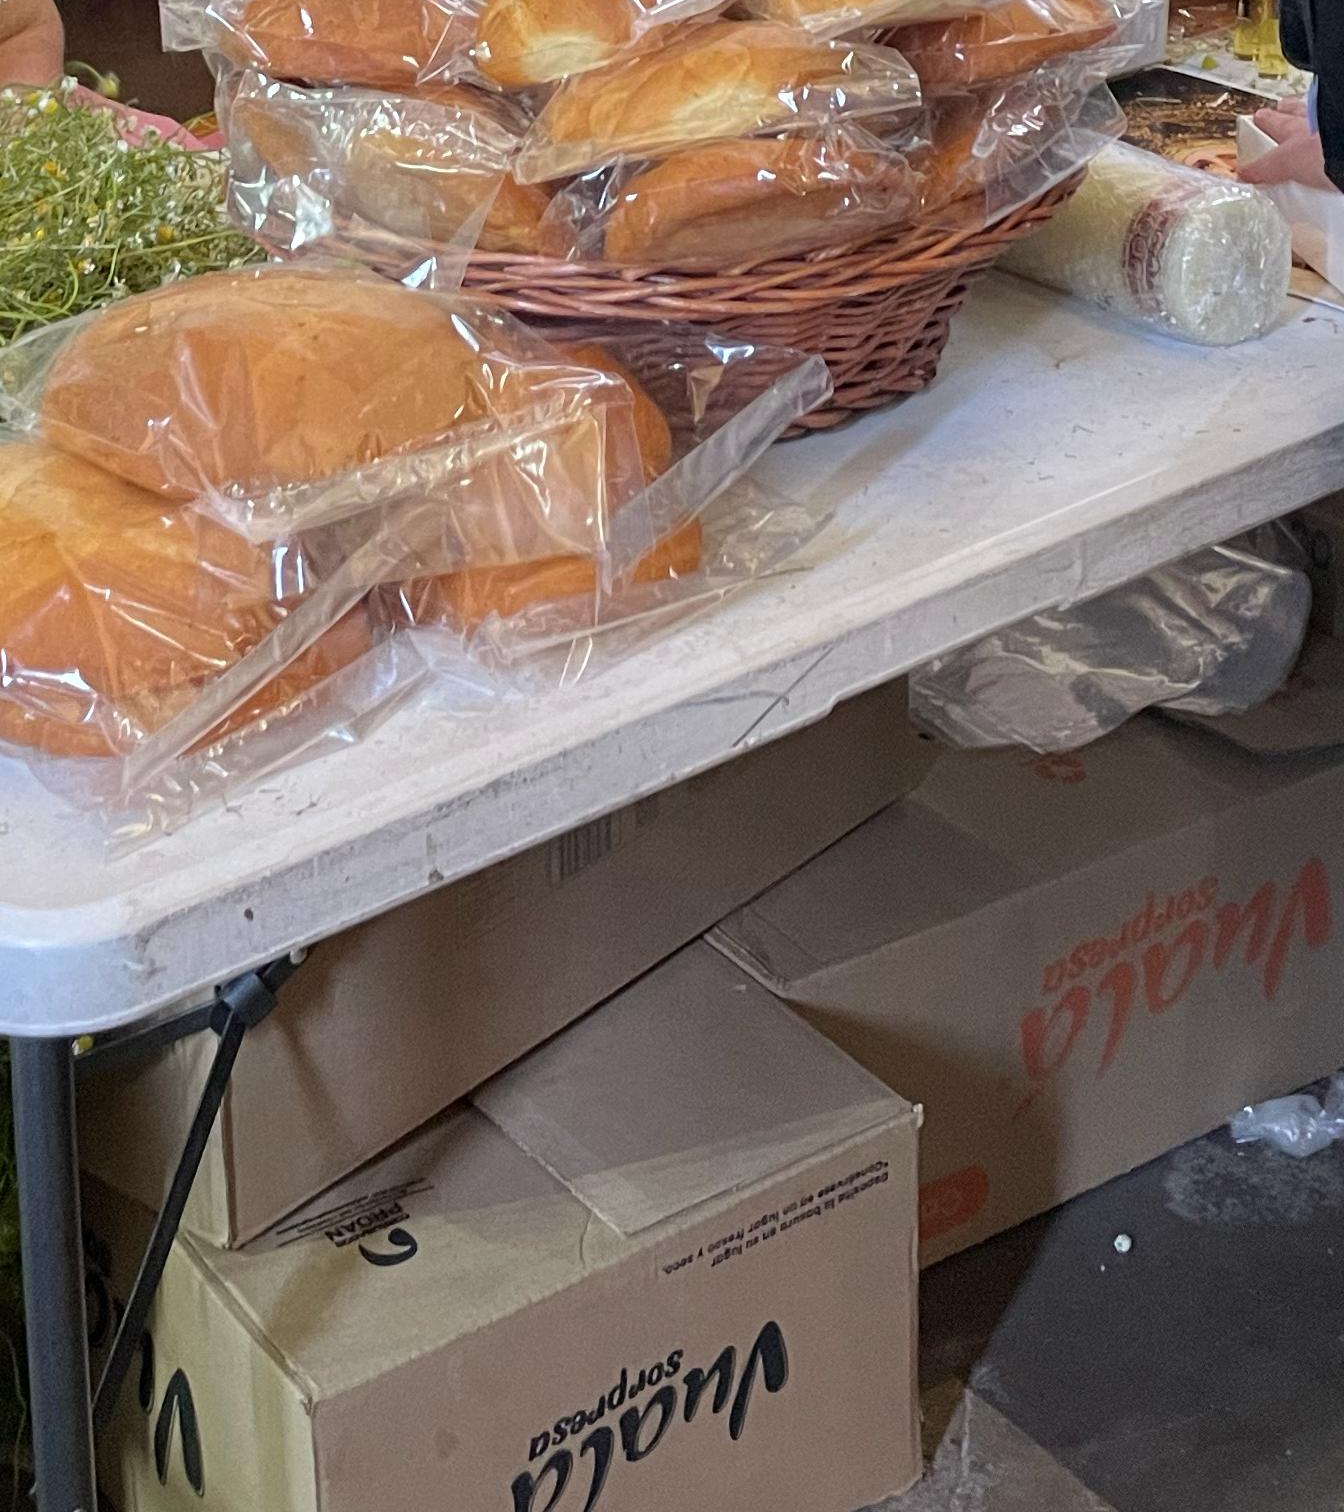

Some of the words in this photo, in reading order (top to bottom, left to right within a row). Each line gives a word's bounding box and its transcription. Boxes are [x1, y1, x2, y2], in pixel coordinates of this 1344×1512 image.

[779, 1205, 823, 1232] basura
[710, 1244, 744, 1269] lugar
[528, 1348, 684, 1462] sorpresa
